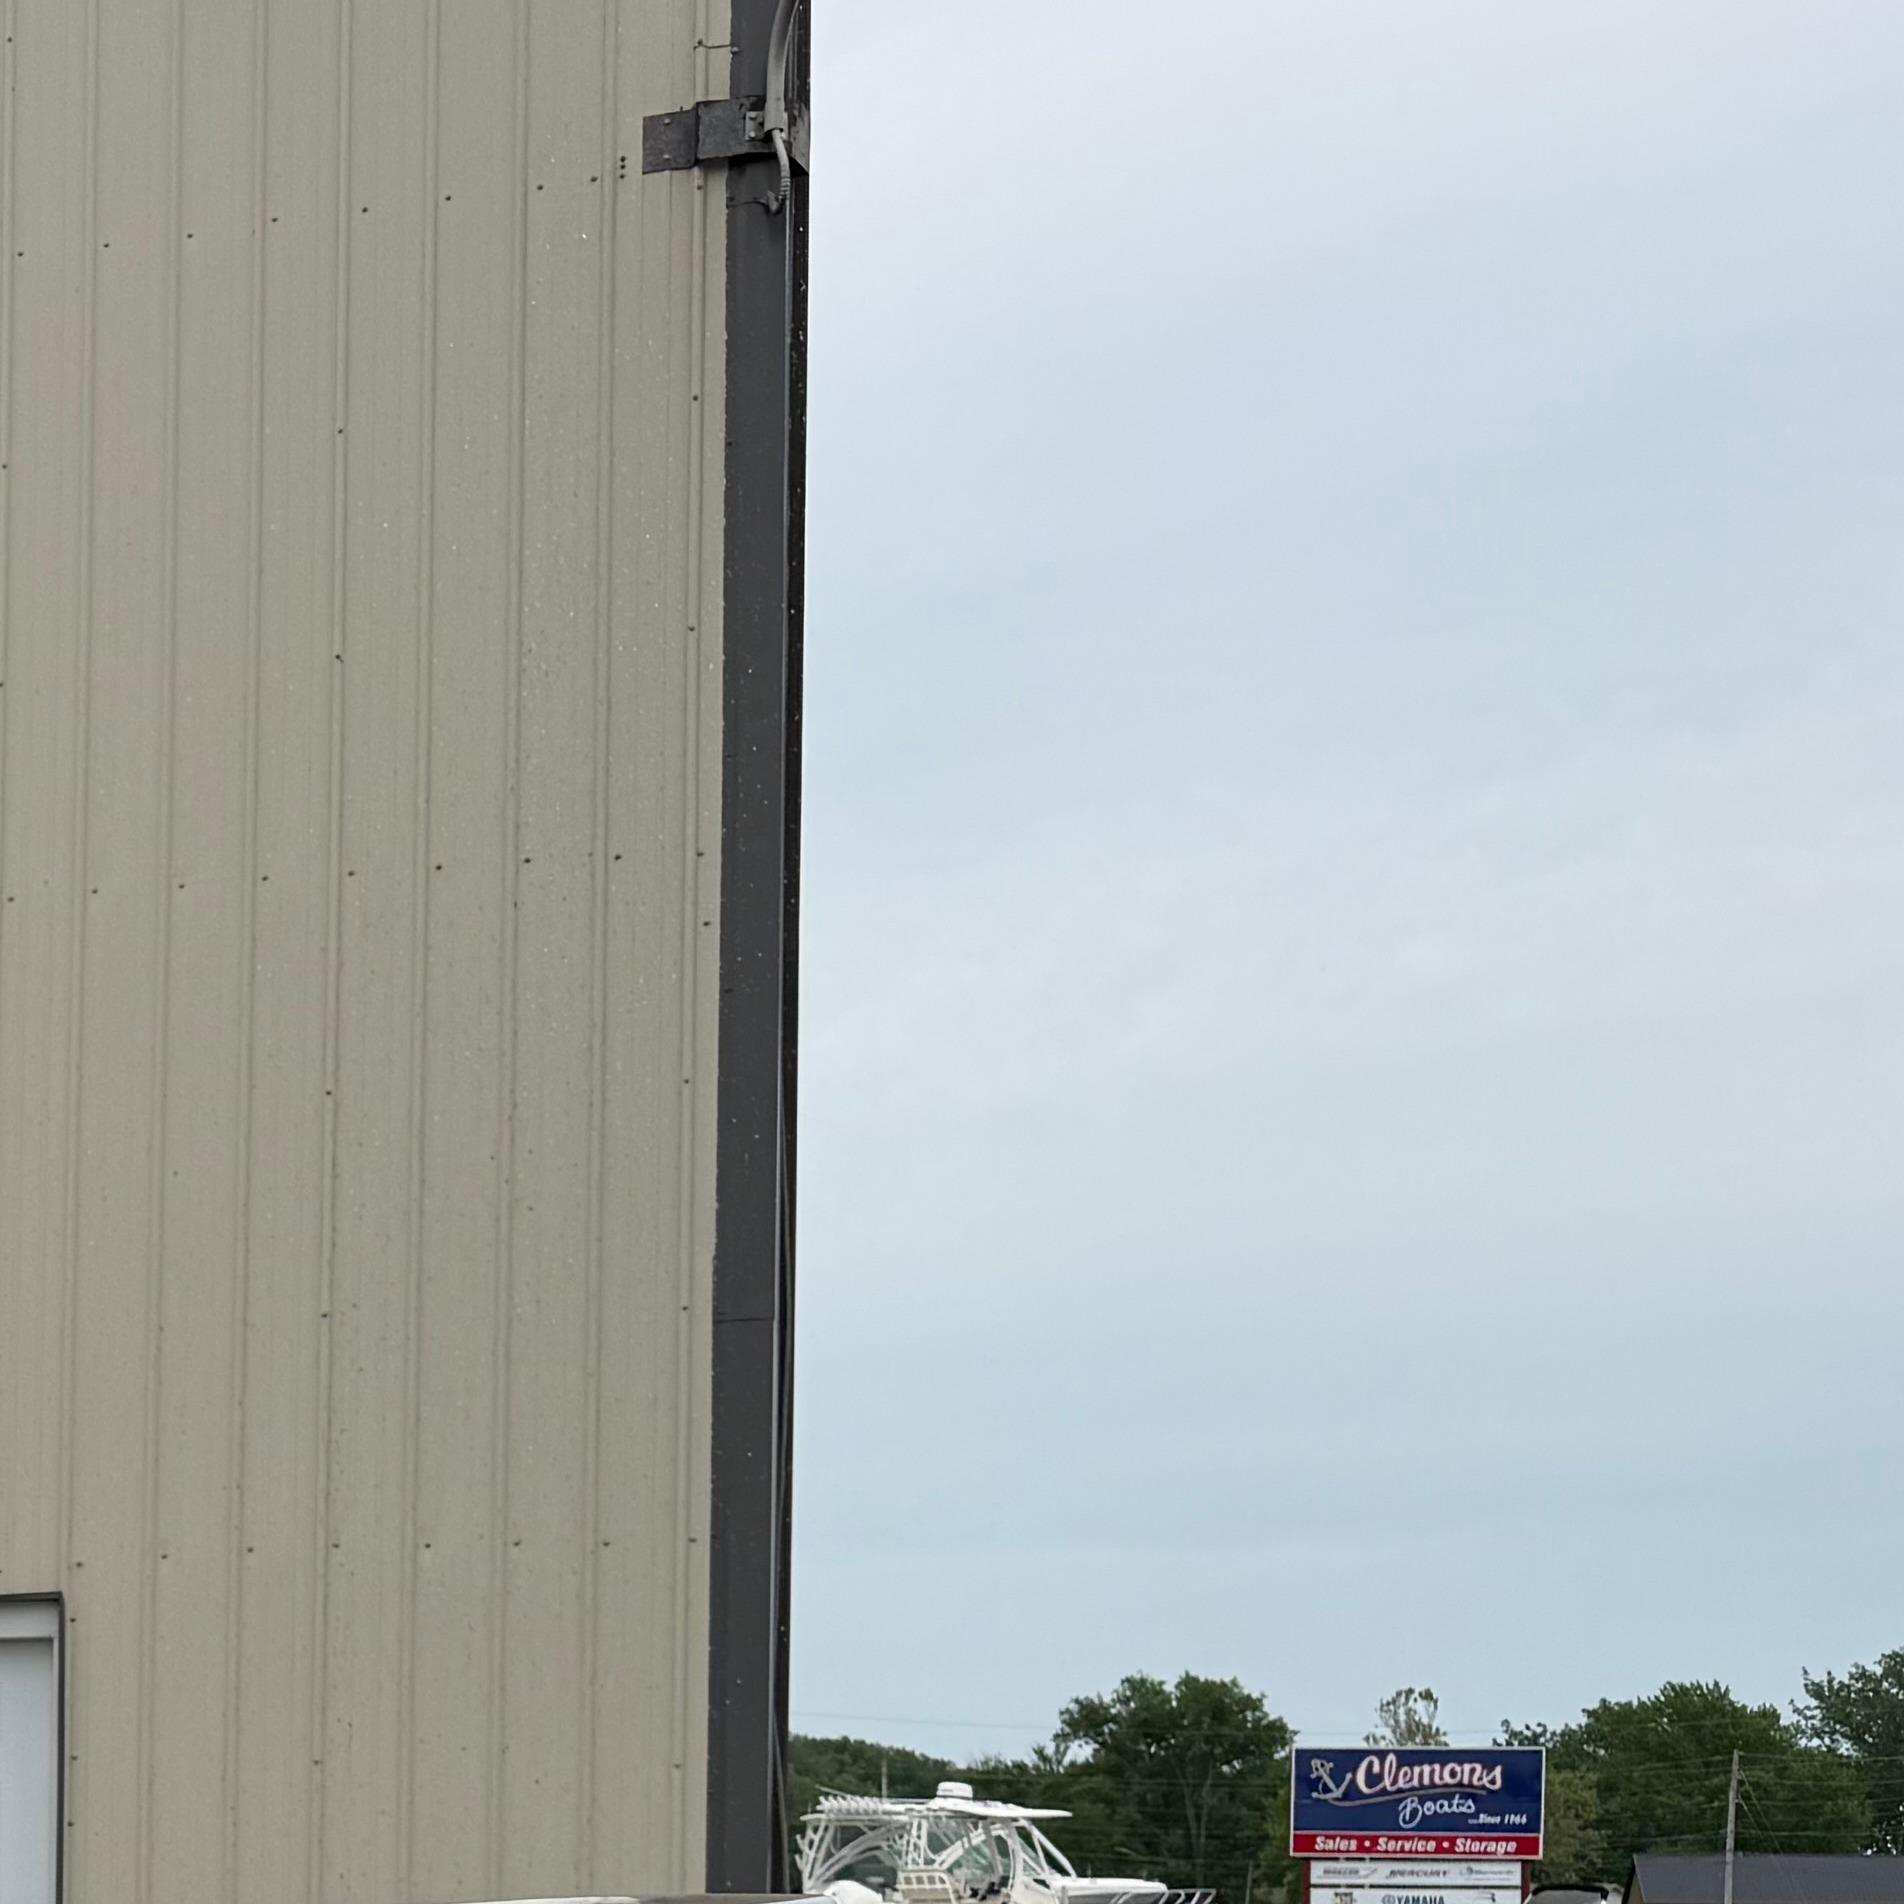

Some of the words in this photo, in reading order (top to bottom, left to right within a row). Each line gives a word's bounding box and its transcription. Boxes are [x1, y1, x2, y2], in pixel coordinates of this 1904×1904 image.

[1356, 1753, 1502, 1794] Clemons
[1398, 1794, 1476, 1829] Boats
[1315, 1836, 1357, 1851] Sales
[1376, 1837, 1436, 1852] Service
[1455, 1838, 1517, 1855] Storage
